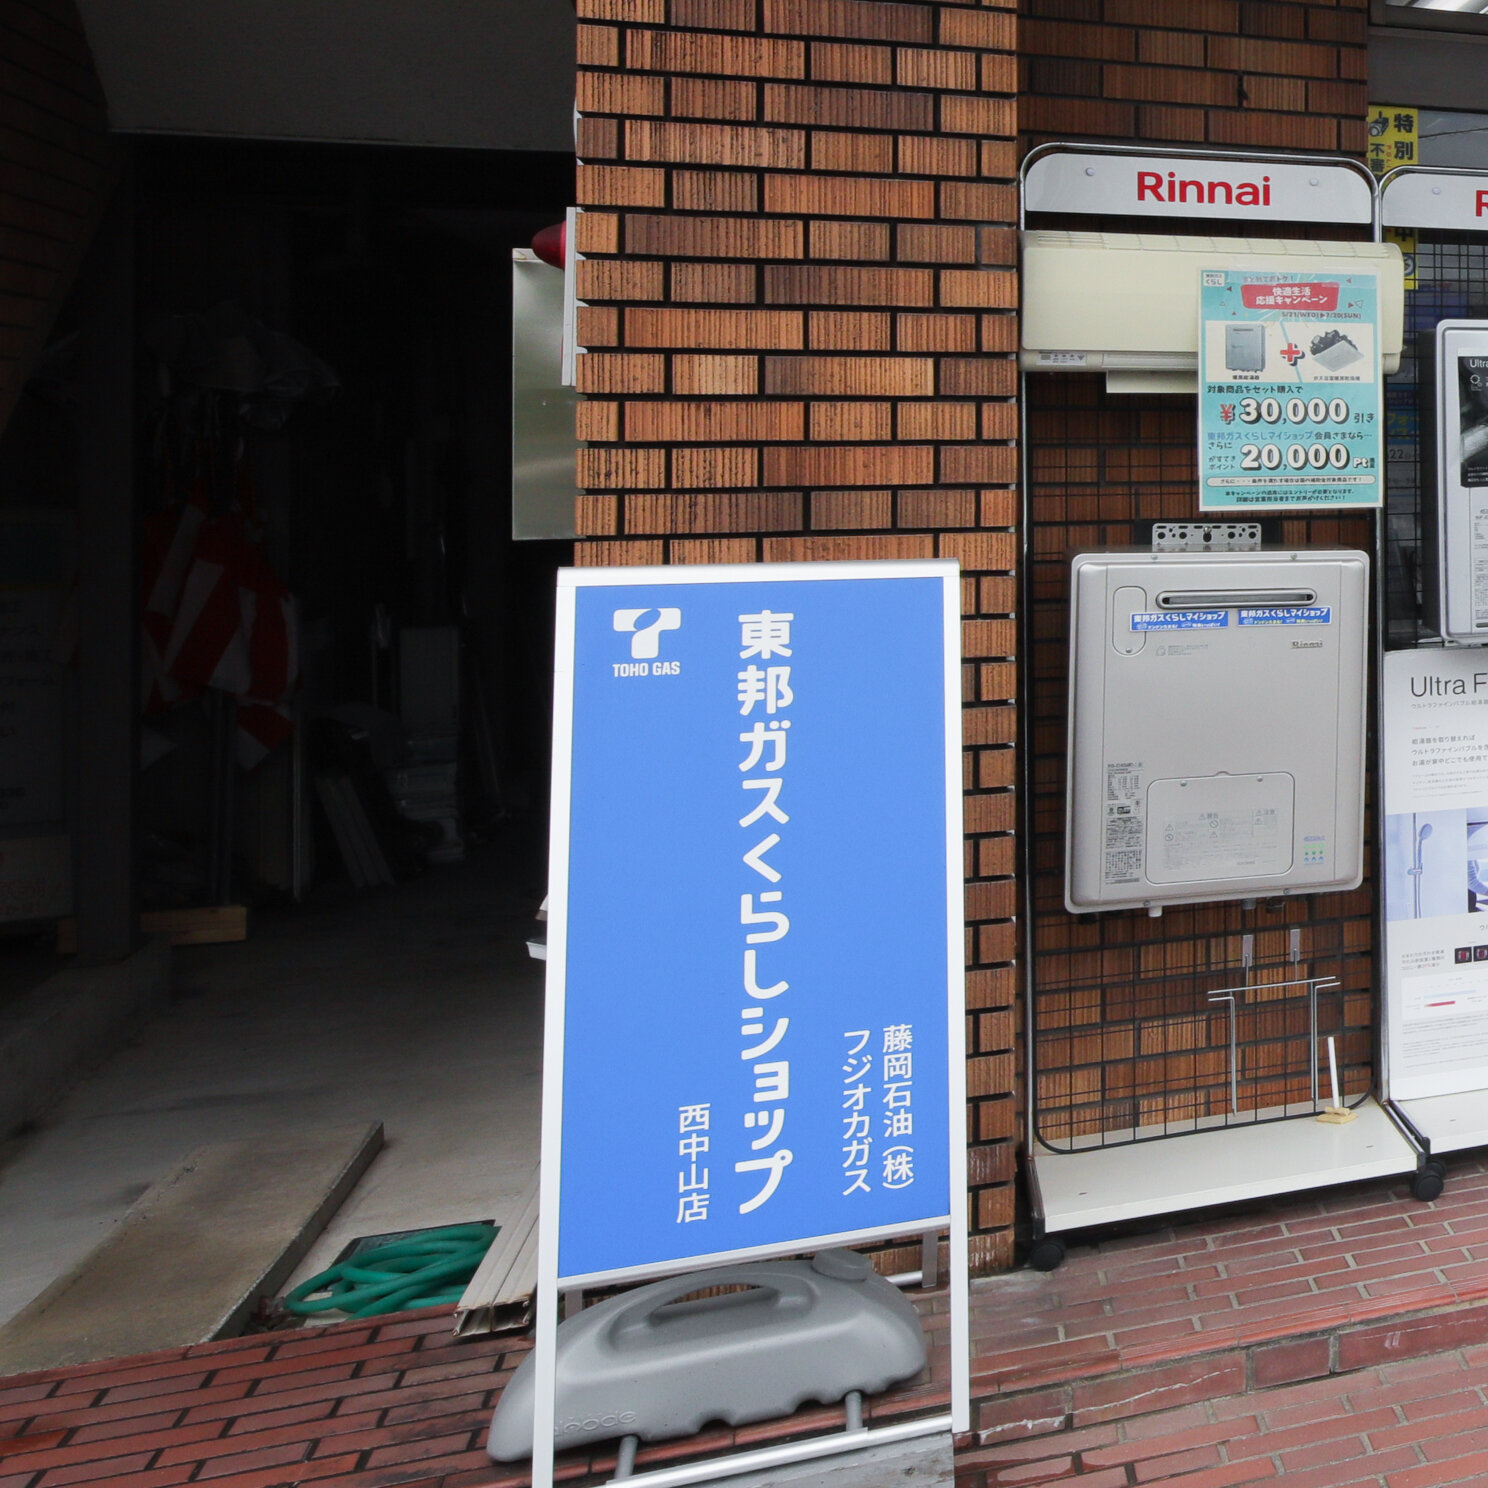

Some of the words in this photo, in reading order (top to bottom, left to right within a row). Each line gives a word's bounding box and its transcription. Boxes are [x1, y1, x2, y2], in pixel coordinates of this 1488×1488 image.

[1136, 170, 1271, 207] Rinnai
[1256, 295, 1328, 305] 応援キャンペーン
[1272, 286, 1311, 296] 快適生活
[1208, 442, 1233, 450] さらに
[1239, 443, 1351, 471] 20,000
[612, 661, 649, 678] TOHO
[652, 660, 681, 677] GAS
[1410, 676, 1467, 697] Ultra
[735, 609, 795, 1215] 東邦ガスくらしショップ
[841, 1029, 872, 1197] フジオカガス
[882, 1023, 915, 1192] 藤岡石油(株)
[676, 1102, 711, 1224] 西中山店
